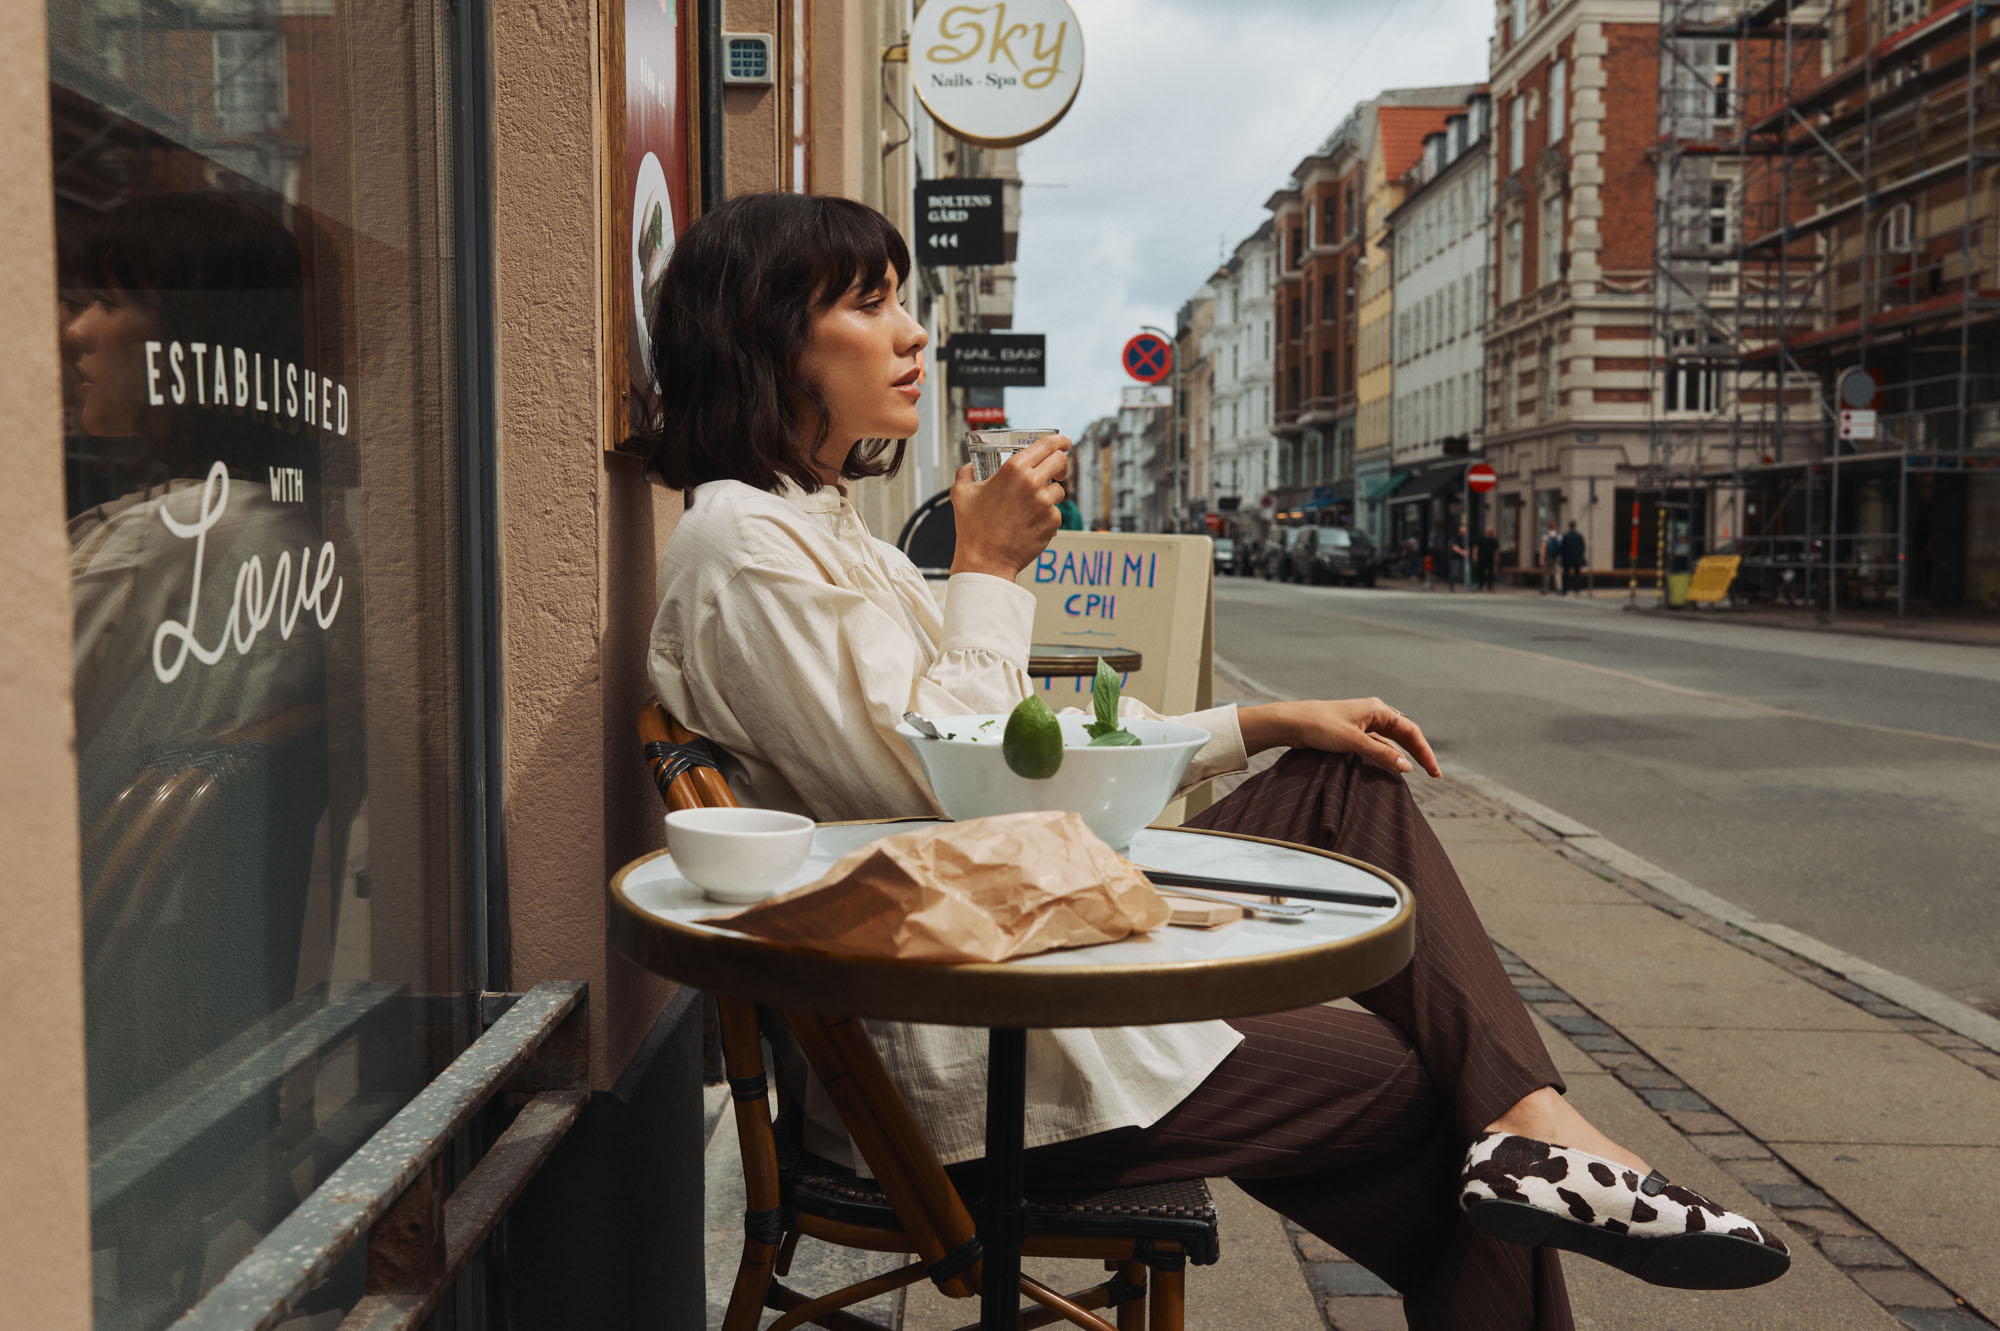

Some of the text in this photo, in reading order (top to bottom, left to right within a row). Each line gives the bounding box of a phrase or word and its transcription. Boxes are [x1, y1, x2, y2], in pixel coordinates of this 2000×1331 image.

[926, 3, 1067, 89] Sky
[931, 73, 973, 88] Nails
[985, 73, 1017, 90] Spa
[928, 194, 992, 208] BOLTENS
[146, 341, 349, 436] ESTABLISHED
[269, 466, 303, 503] WITH
[153, 461, 343, 683] Love
[1121, 551, 1158, 588] MI
[1064, 593, 1118, 620] CPH
